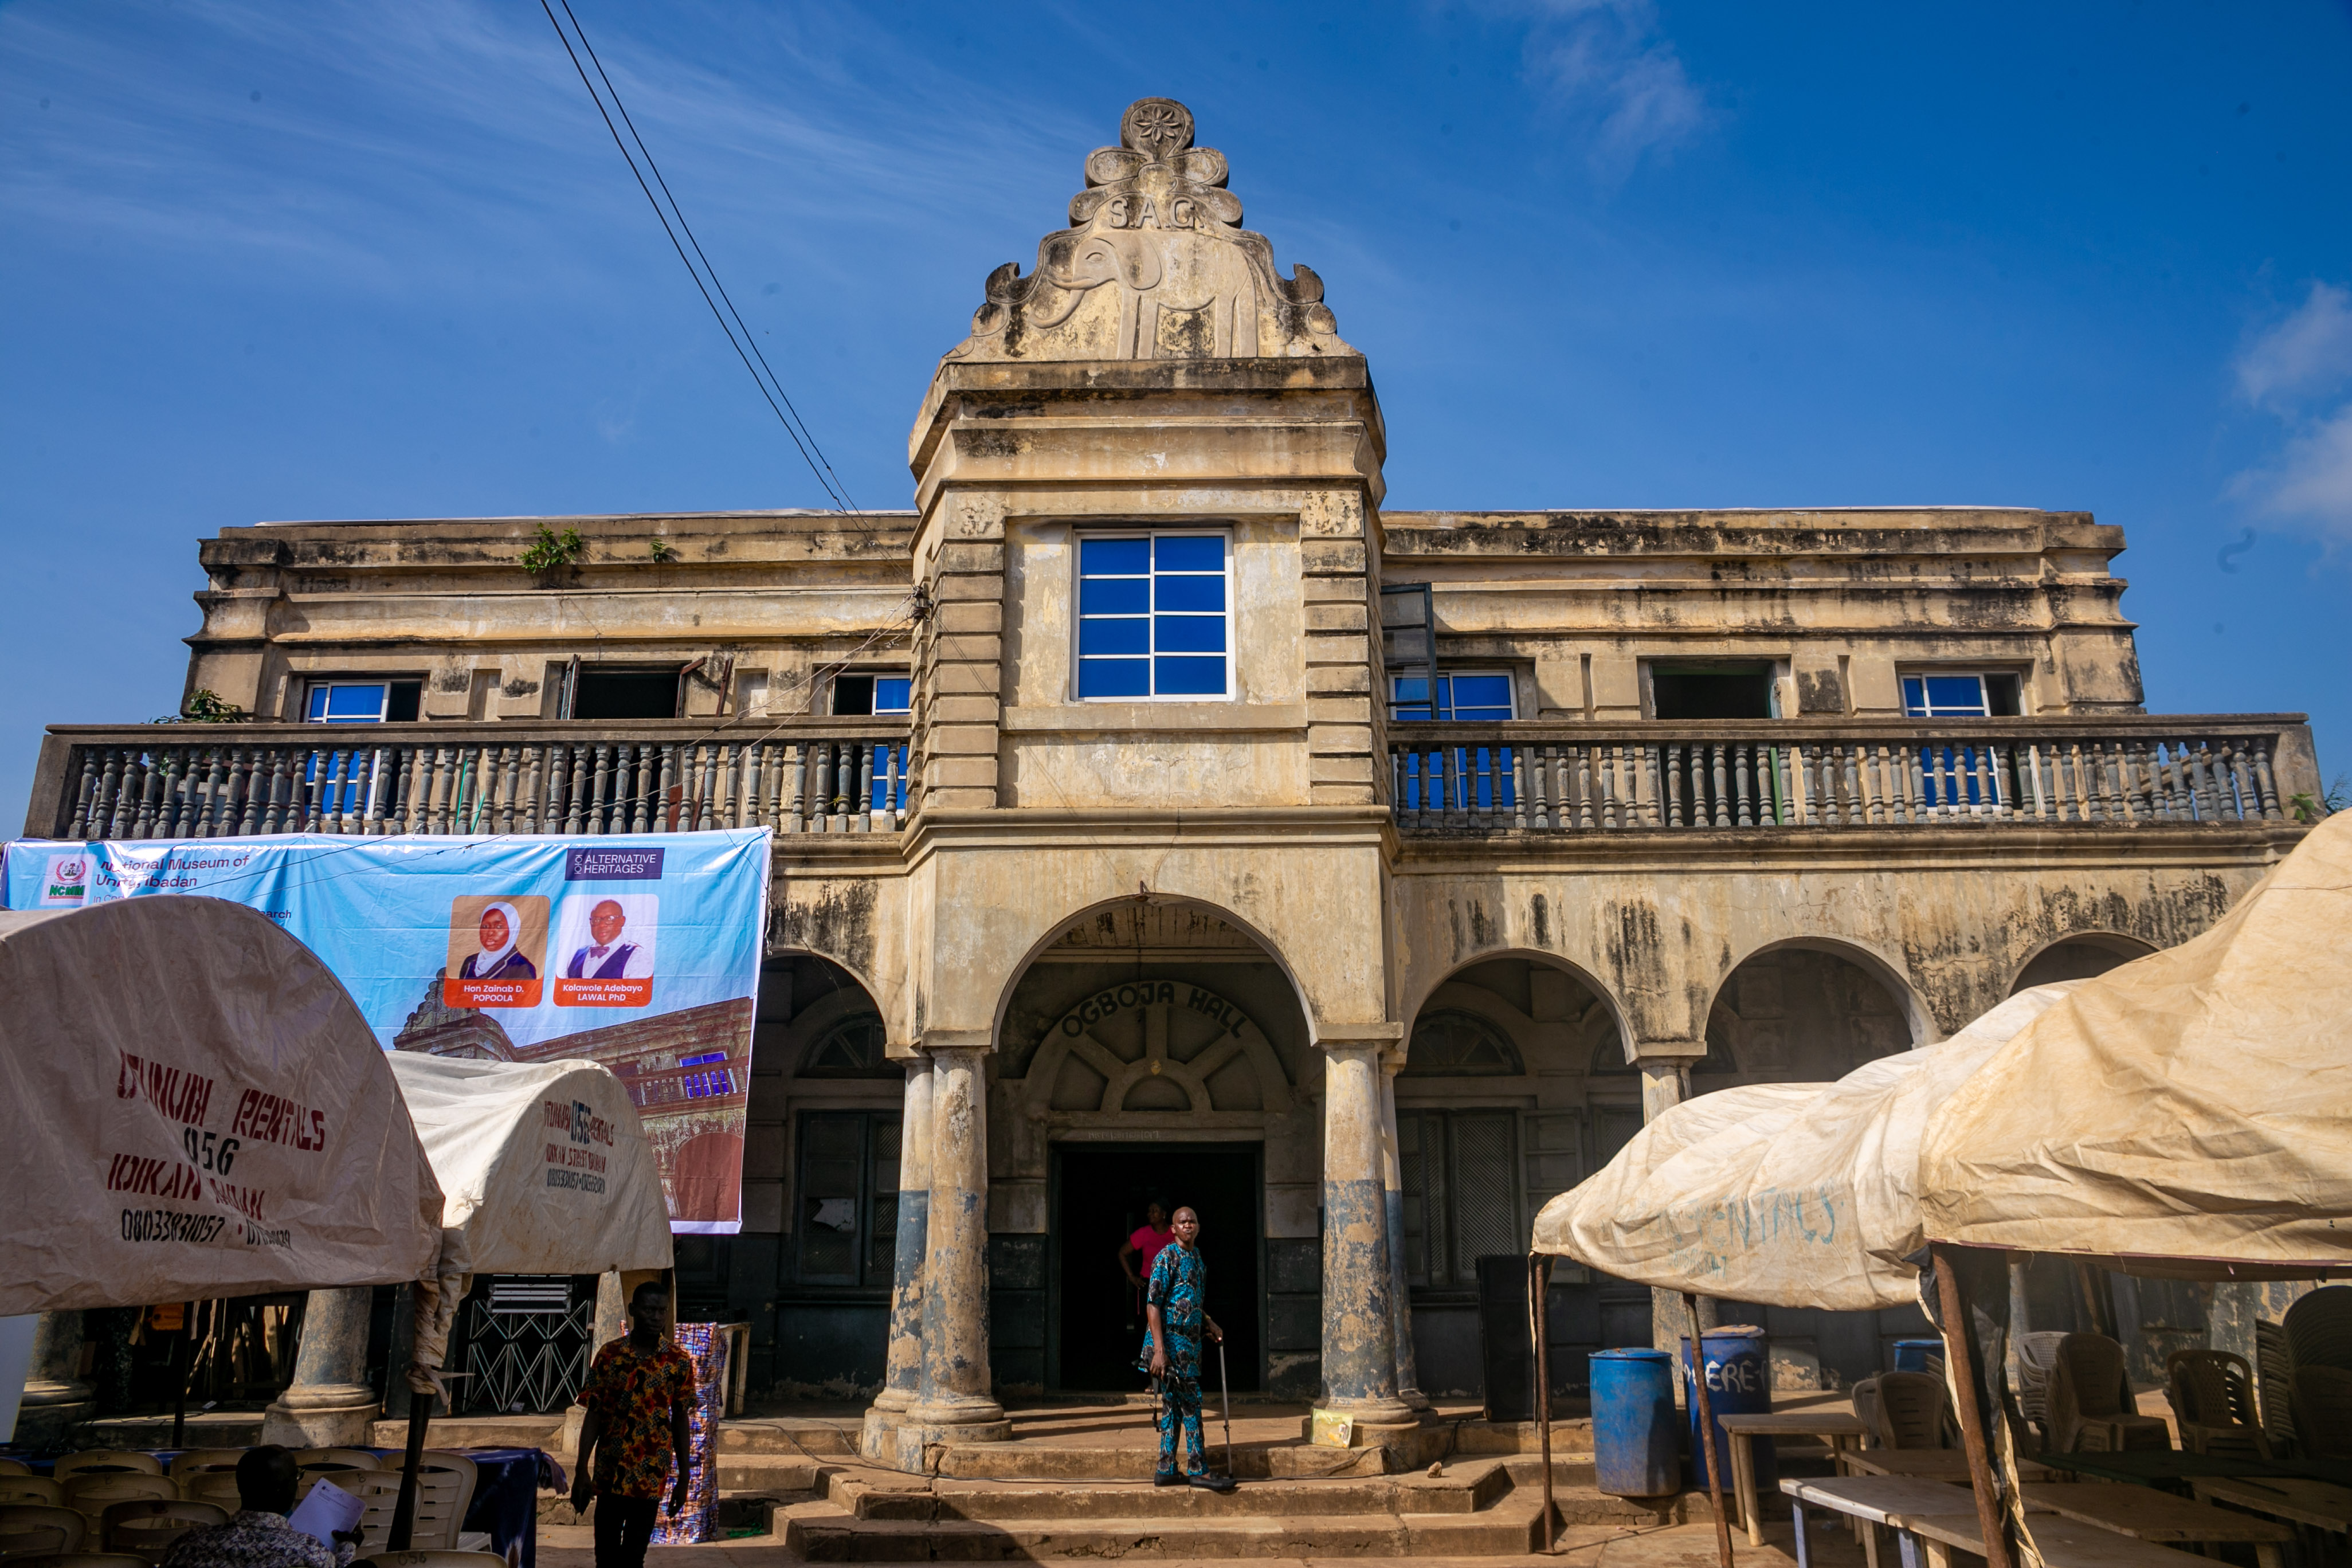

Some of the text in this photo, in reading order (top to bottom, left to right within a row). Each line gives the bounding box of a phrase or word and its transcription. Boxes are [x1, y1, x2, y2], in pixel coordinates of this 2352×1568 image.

[167, 857, 229, 871] Museum
[233, 855, 250, 867] of
[584, 854, 657, 864] ALTERNATIVE
[583, 864, 644, 874] HERITAGES
[144, 876, 197, 888] Ibadan
[49, 884, 85, 896] NCMM
[464, 985, 524, 993] Hon Zainab D.
[563, 984, 643, 994] Kolawole Adebayo
[578, 993, 626, 1001] LAWAL PhD
[1061, 982, 1247, 1038] OGBOJA HALL
[571, 1099, 591, 1144] 056
[184, 1127, 240, 1176] 056
[107, 1153, 202, 1201] IDIKAN
